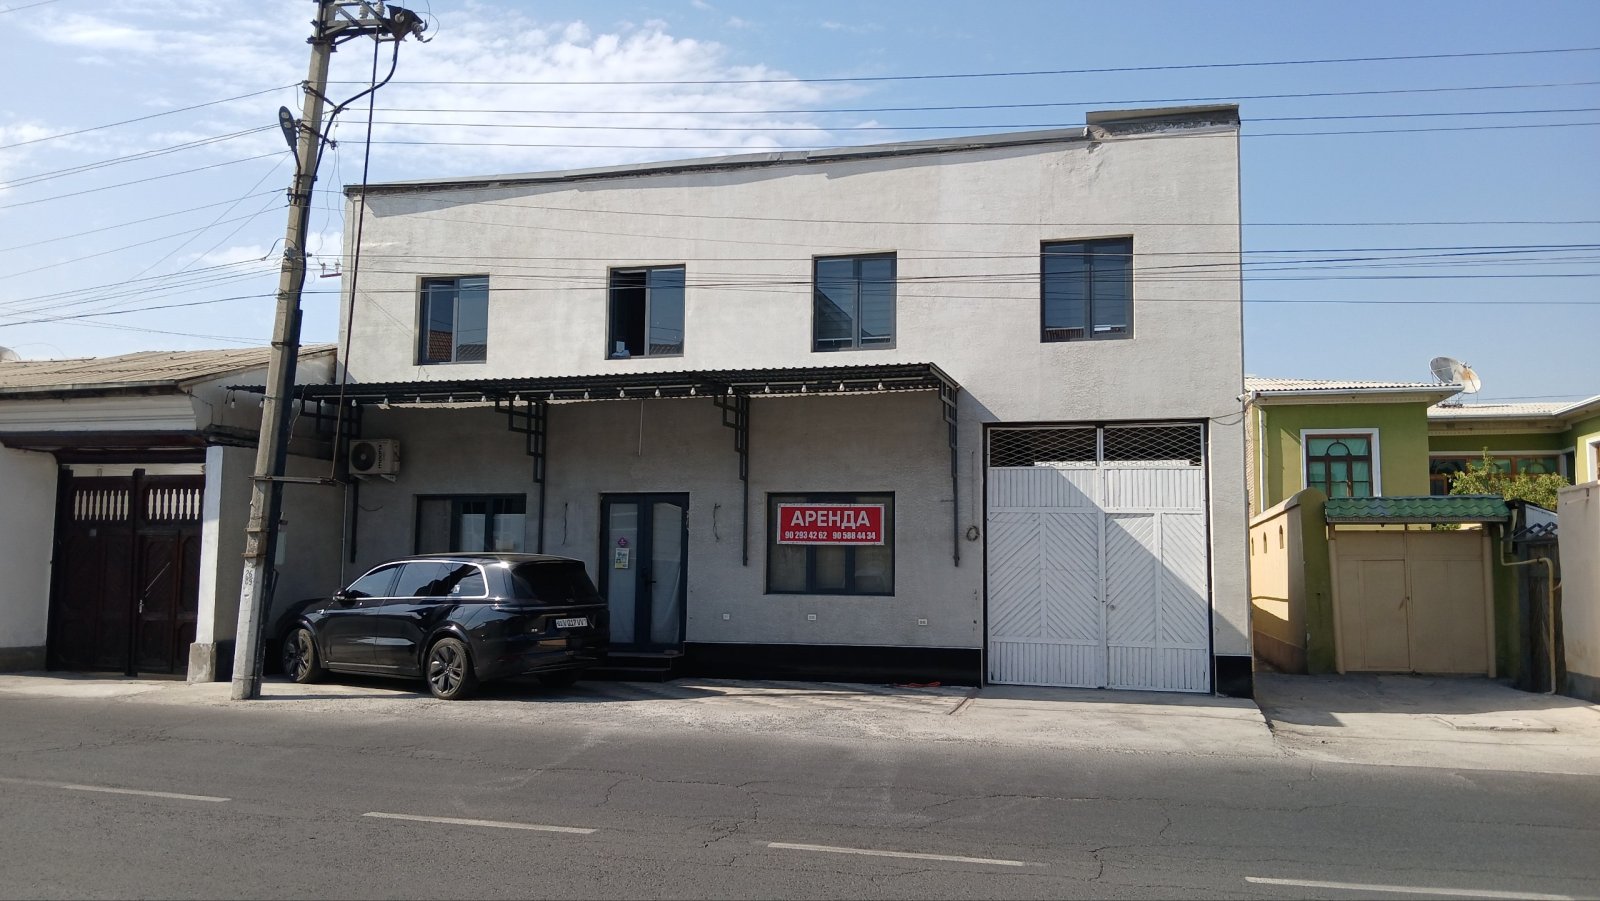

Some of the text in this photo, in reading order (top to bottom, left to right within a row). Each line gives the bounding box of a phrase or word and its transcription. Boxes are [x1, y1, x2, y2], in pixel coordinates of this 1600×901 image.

[790, 510, 870, 530] АРЕНДА
[785, 530, 794, 539] 90
[794, 530, 808, 539] 293
[808, 531, 817, 539] 42
[818, 531, 828, 539] 62
[832, 531, 841, 539] 90
[856, 531, 866, 539] 44
[866, 531, 876, 539] 34
